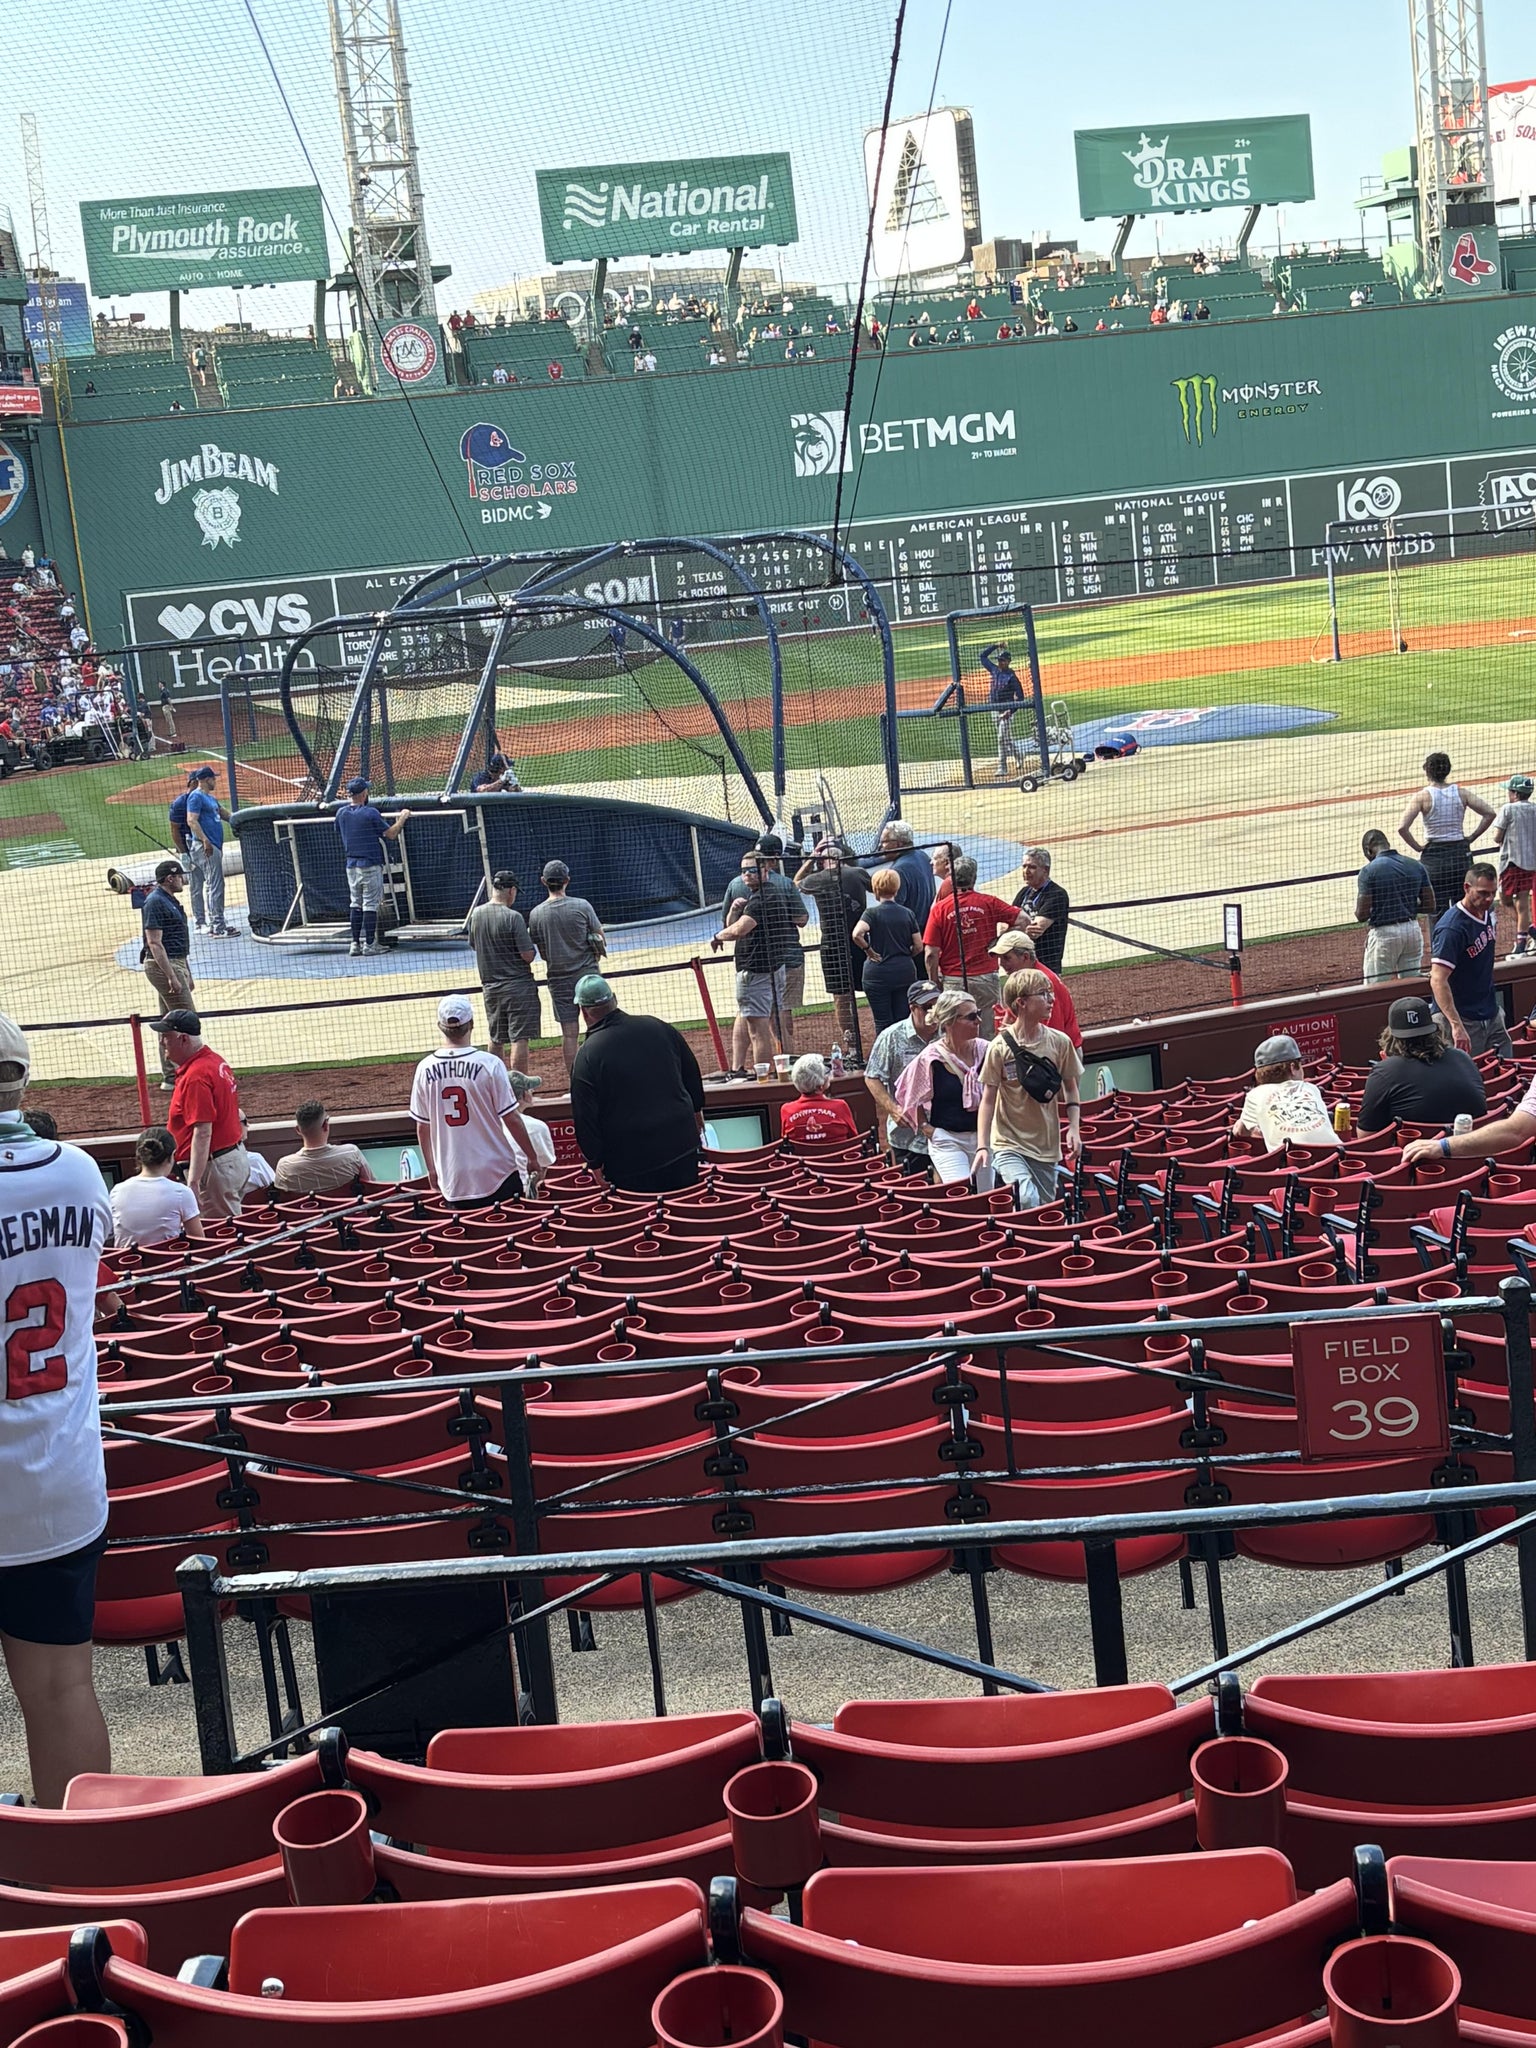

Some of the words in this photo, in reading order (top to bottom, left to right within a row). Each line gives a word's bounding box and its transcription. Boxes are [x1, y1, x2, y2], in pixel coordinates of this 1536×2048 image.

[1234, 138, 1251, 148] 21+
[1133, 153, 1252, 188] DRAFT
[1151, 178, 1251, 206] KINGS
[100, 208, 128, 220] More
[130, 206, 154, 218] Than
[154, 205, 176, 217] Just
[670, 221, 700, 237] Car
[707, 215, 765, 235] Rental
[112, 218, 229, 254] Plymouth
[237, 213, 300, 243] Rock
[179, 272, 204, 281] AUTO
[217, 269, 244, 279] HOME
[1493, 325, 1527, 351] IBEW
[1238, 404, 1308, 419] ENERGY
[859, 410, 1016, 454] BETMGM
[477, 467, 523, 486] RED
[530, 461, 577, 480] SOX
[479, 480, 578, 501] SCHOLARS
[1115, 497, 1174, 511] NATIONAL
[1179, 490, 1226, 504] LEAGUE
[1220, 503, 1227, 512] P
[1275, 497, 1283, 506] R
[481, 505, 534, 524] BIDMC
[1142, 511, 1148, 521] P
[1198, 506, 1205, 515] R
[1236, 513, 1255, 524] CHC
[909, 518, 974, 533] AMERICAN
[979, 512, 1028, 526] LEAGUE
[1063, 520, 1069, 530] P
[1119, 514, 1126, 524] R
[1158, 523, 1176, 533] COL
[976, 529, 983, 539] P
[1020, 524, 1030, 535] IN
[1035, 522, 1043, 533] R
[1240, 524, 1252, 534] SF
[1349, 524, 1378, 534] YEARS
[898, 538, 905, 547] P
[941, 533, 952, 543] IN
[956, 532, 963, 541] R
[1079, 532, 1097, 541] STL
[1160, 533, 1176, 543] ATH
[1240, 534, 1254, 545] PHI
[849, 543, 857, 553] R
[864, 541, 872, 551] H
[879, 540, 885, 550] E
[996, 541, 1009, 550] TB
[1081, 542, 1097, 551] MIN
[1161, 545, 1177, 554] ATL
[914, 549, 935, 559] HOU
[994, 551, 1012, 561] LAA
[1082, 553, 1097, 563] MIA
[677, 561, 684, 571] P
[919, 560, 932, 570] KC
[1165, 565, 1176, 574] AZ
[692, 571, 724, 583] TEXAS
[996, 573, 1014, 582] TOR
[1083, 574, 1100, 584] SEA
[1163, 576, 1179, 585] CIN
[365, 579, 383, 589] AL
[919, 581, 936, 591] BAL
[997, 584, 1015, 594] LAD
[1083, 584, 1101, 594] WSH
[691, 585, 727, 597] BOSTON
[920, 592, 937, 602] DET
[997, 595, 1015, 604] CWS
[767, 601, 794, 614] RIKE
[920, 603, 939, 613] CLE
[209, 593, 312, 637] CVS
[346, 638, 391, 651] TOROO
[401, 636, 413, 646] 33
[347, 651, 398, 665] BALTORE
[1272, 1018, 1334, 1036] CAUTION!
[425, 1061, 483, 1084] ANTHONY
[441, 1086, 469, 1127] 3
[5, 1277, 68, 1400] 2
[1324, 1336, 1410, 1360] FIELD
[1339, 1363, 1400, 1385] BOX
[1329, 1396, 1419, 1441] 39
